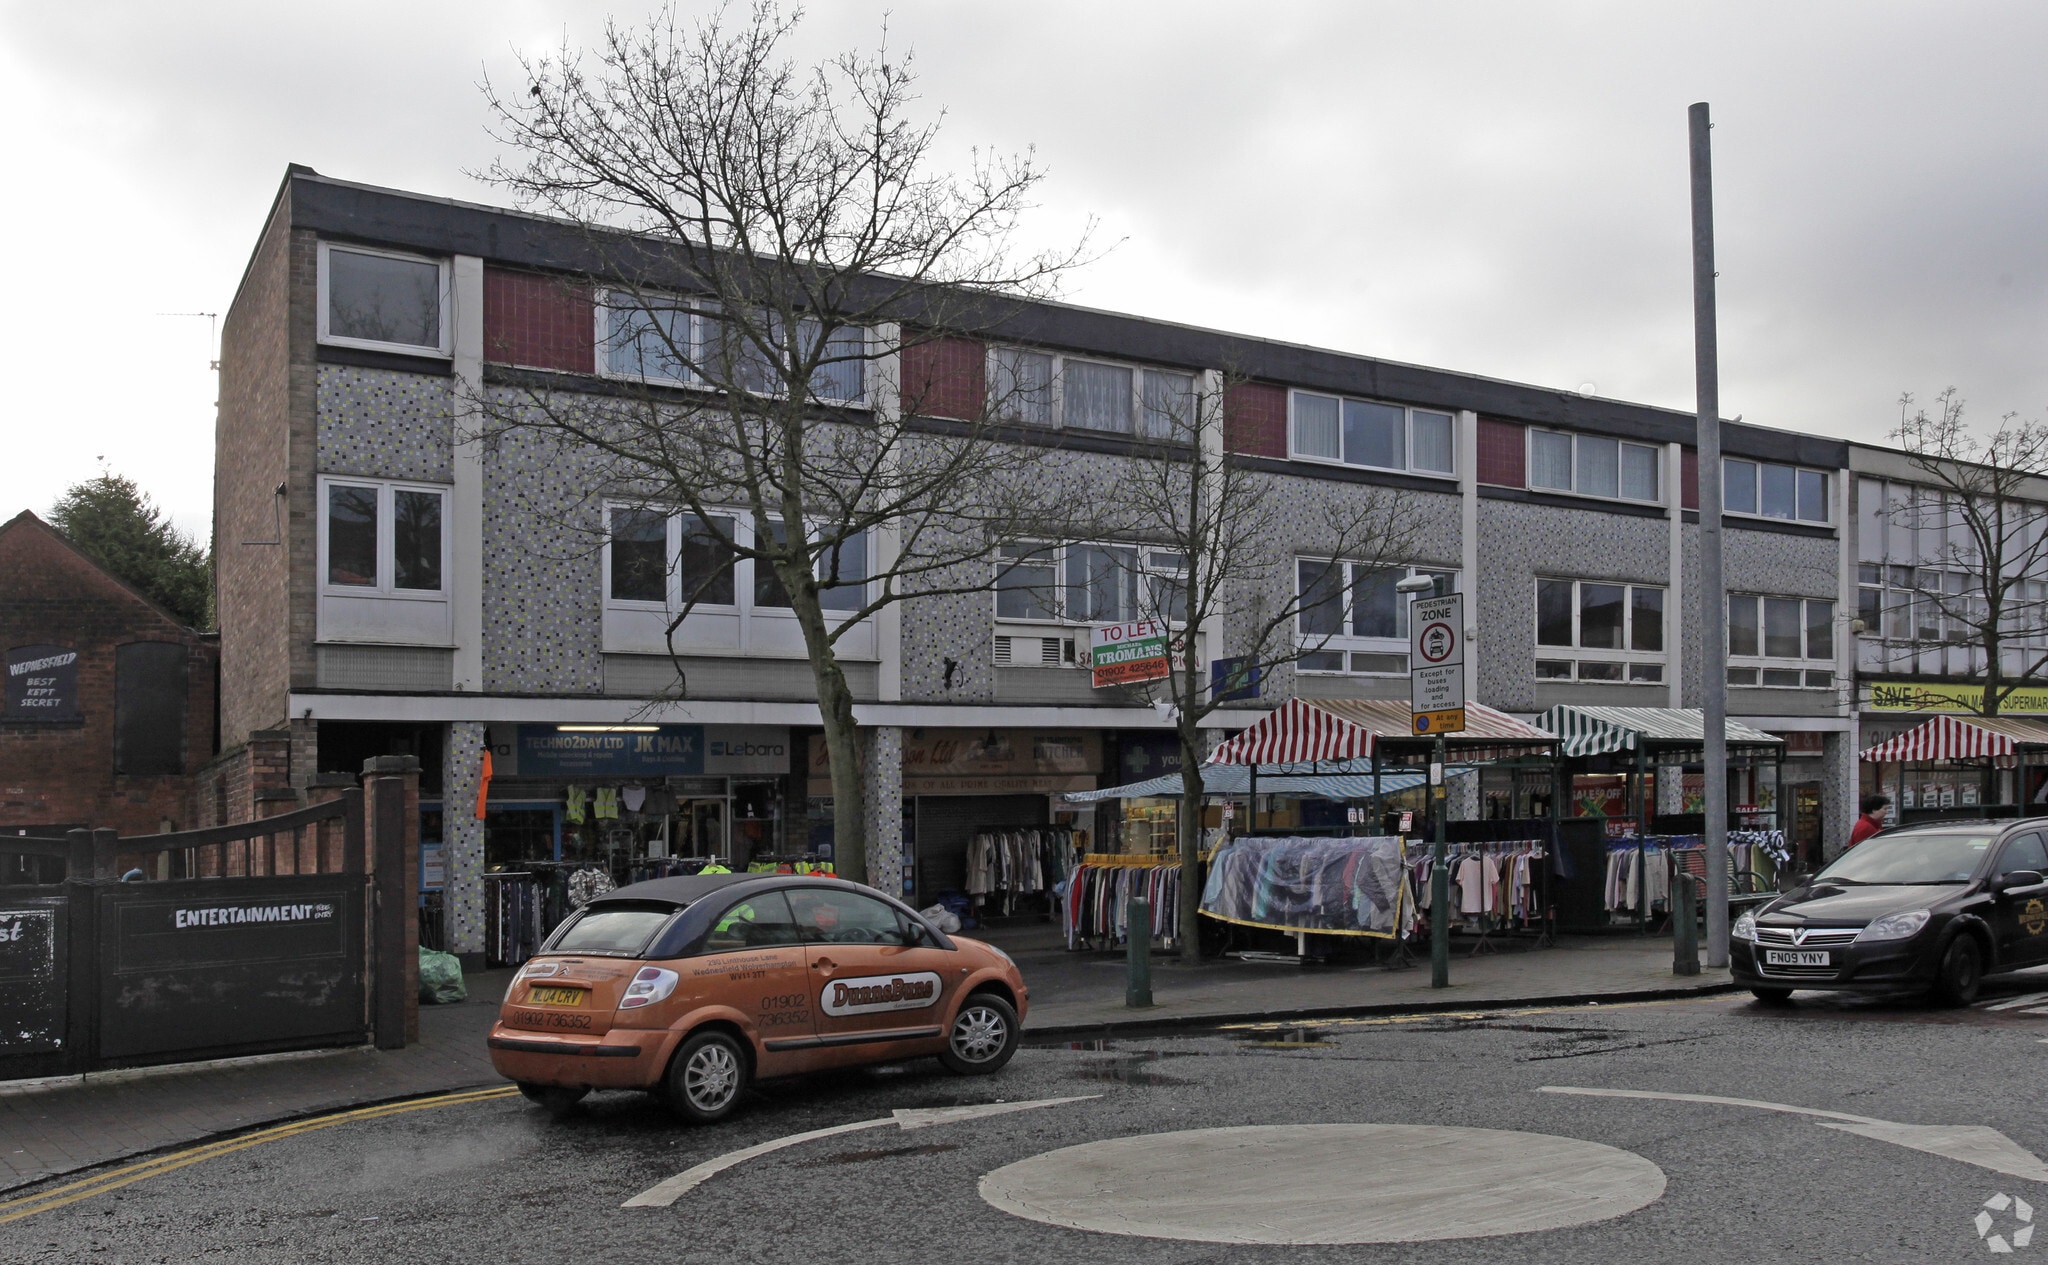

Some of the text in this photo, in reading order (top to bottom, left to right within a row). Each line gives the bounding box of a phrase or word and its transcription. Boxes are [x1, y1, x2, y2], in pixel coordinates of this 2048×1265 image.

[1416, 597, 1457, 609] PEDESTRIAN
[1422, 608, 1451, 621] ZONE
[1101, 620, 1156, 641] TO LET
[1097, 644, 1163, 665] TROMANS
[10, 652, 77, 676] WEDNESFIELD
[1098, 665, 1125, 678] 01902
[1129, 659, 1164, 673] 425646
[1420, 669, 1443, 678] Except
[26, 677, 57, 686] BEST
[1425, 685, 1449, 693] loading
[27, 688, 56, 696] KEPT
[1874, 686, 1911, 707] SAVE
[20, 698, 62, 707] SECRET
[527, 736, 693, 752] TECHNO2DAY LTD JK MAX
[725, 741, 785, 756] Lebara
[1607, 788, 1621, 799] OFF
[175, 904, 313, 929] ENTERTAINMENT
[1771, 952, 1824, 964] FN09 YNY
[692, 961, 797, 976] Wednesfield Wolverhampton
[557, 989, 581, 1003] CRV
[832, 978, 934, 1008] DunnsBuns
[762, 994, 805, 1010] 01902
[513, 1011, 592, 1029] 01902 736352
[757, 1011, 809, 1027] 736352
